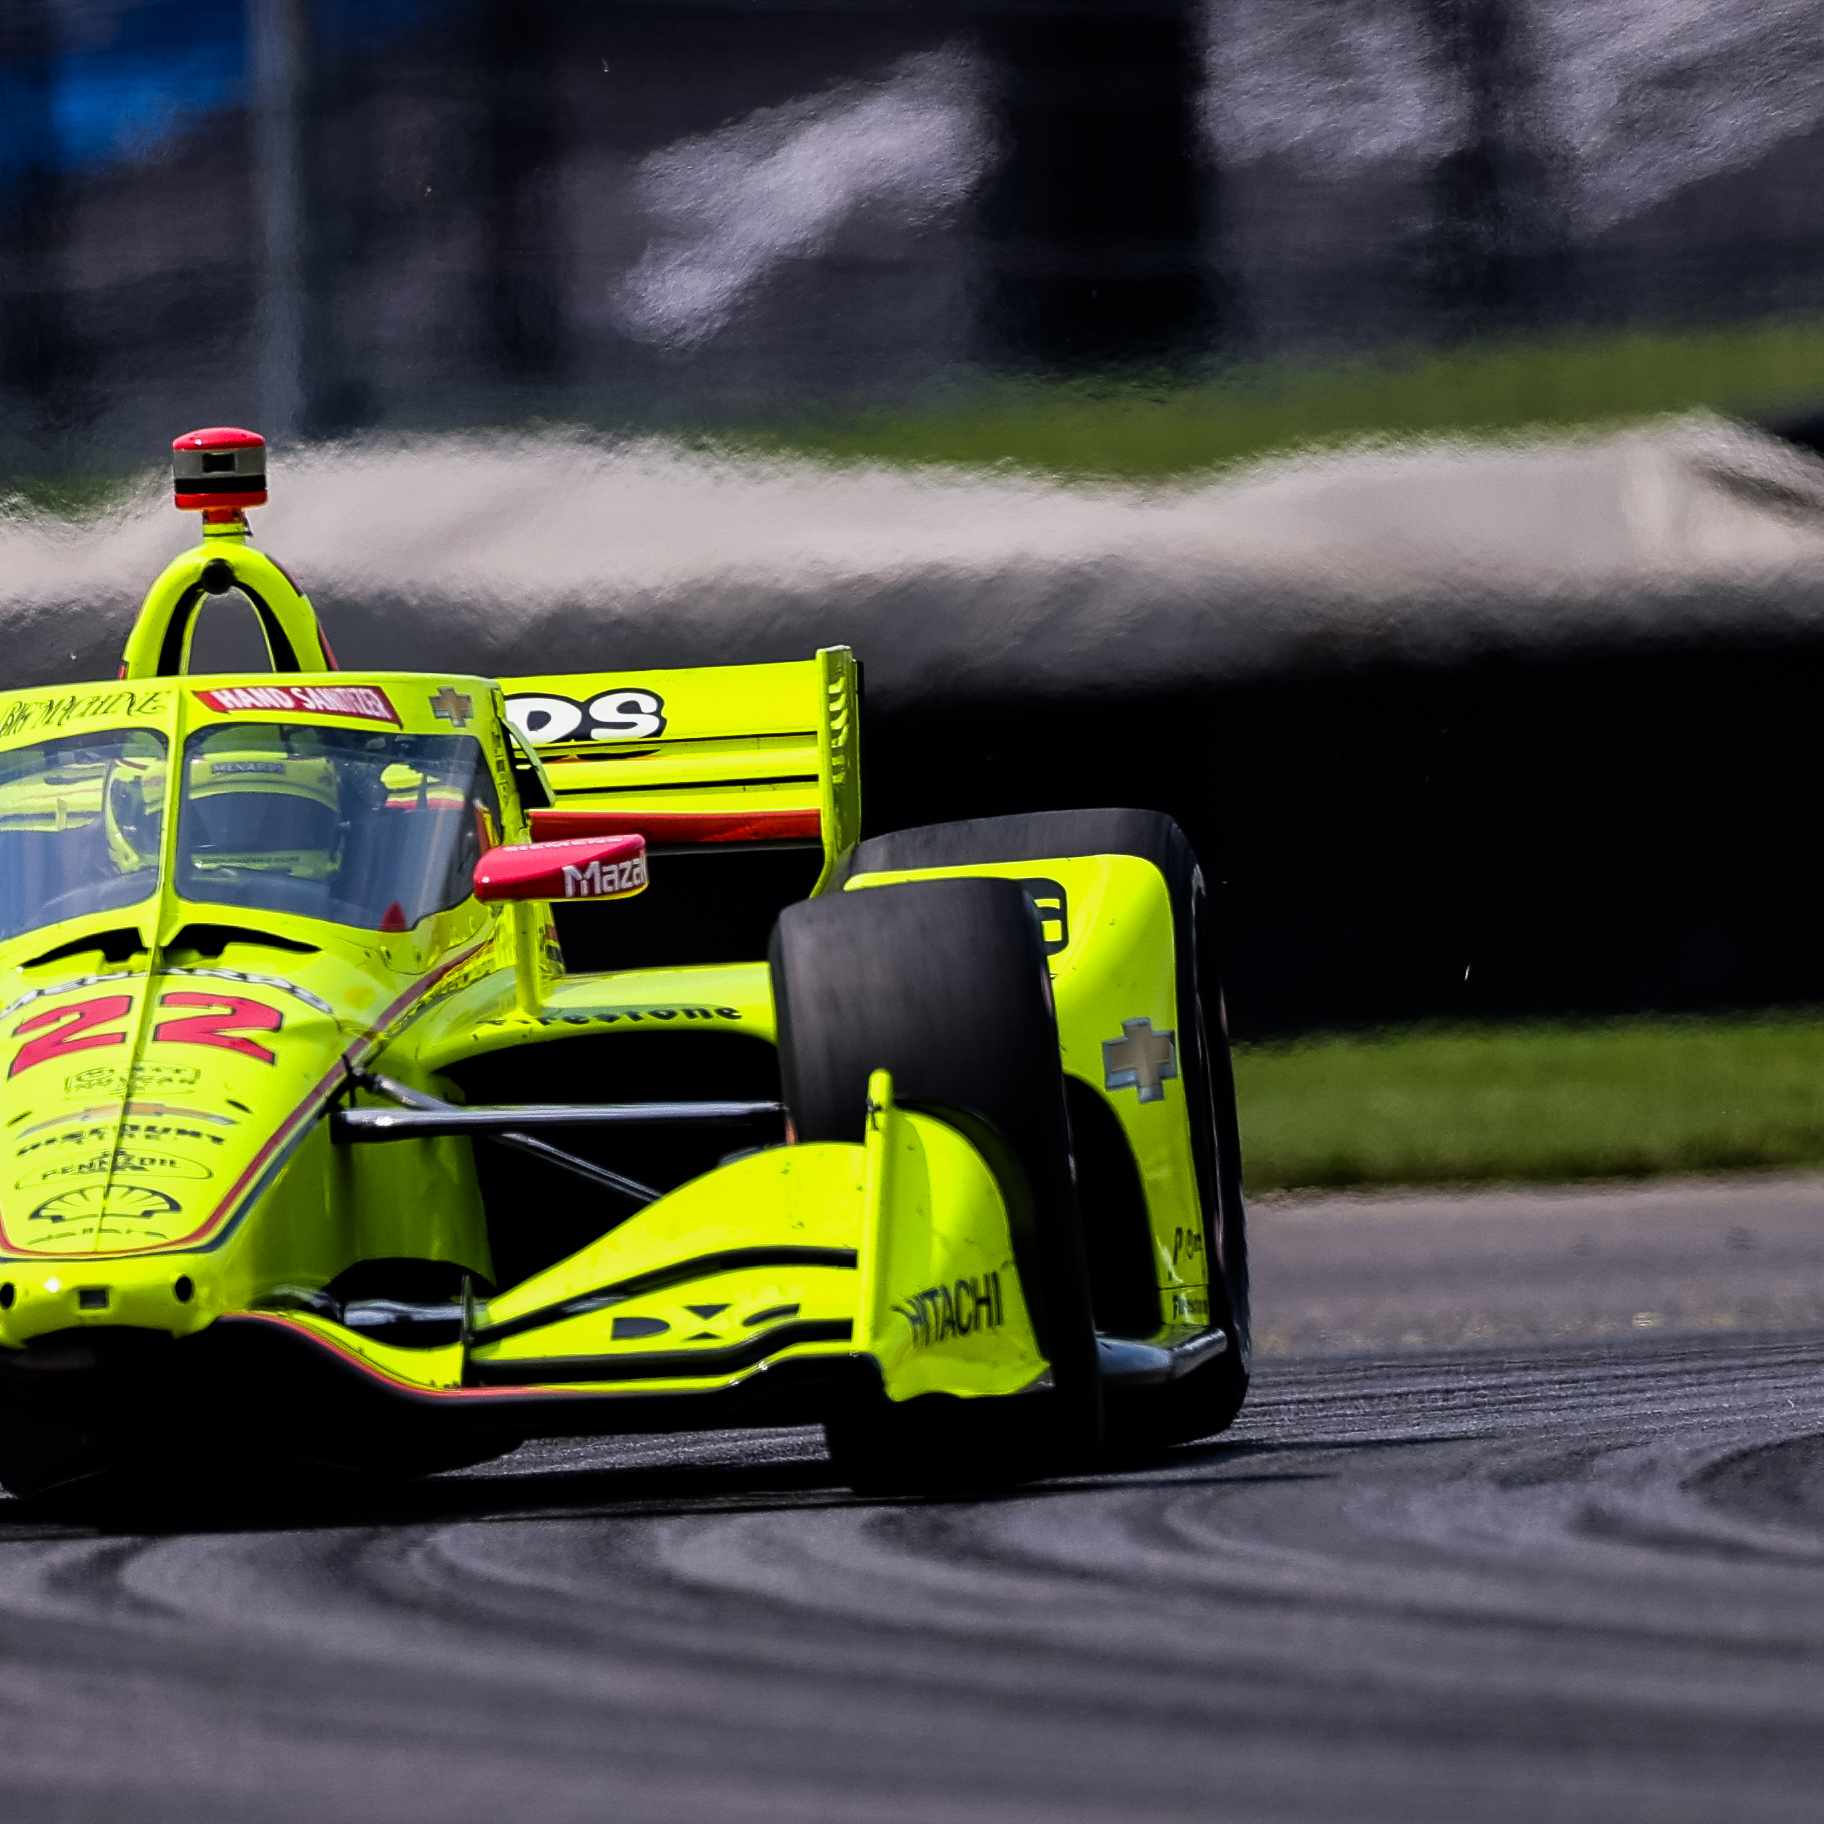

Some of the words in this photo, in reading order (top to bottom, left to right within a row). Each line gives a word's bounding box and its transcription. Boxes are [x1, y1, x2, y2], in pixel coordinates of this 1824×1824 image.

[31, 689, 170, 729] MACHINE
[210, 686, 295, 709] HAND
[290, 687, 393, 720] SANITIZER
[562, 857, 647, 898] Maza
[7, 991, 284, 1082] 22
[889, 1271, 1004, 1349] HITACHI
